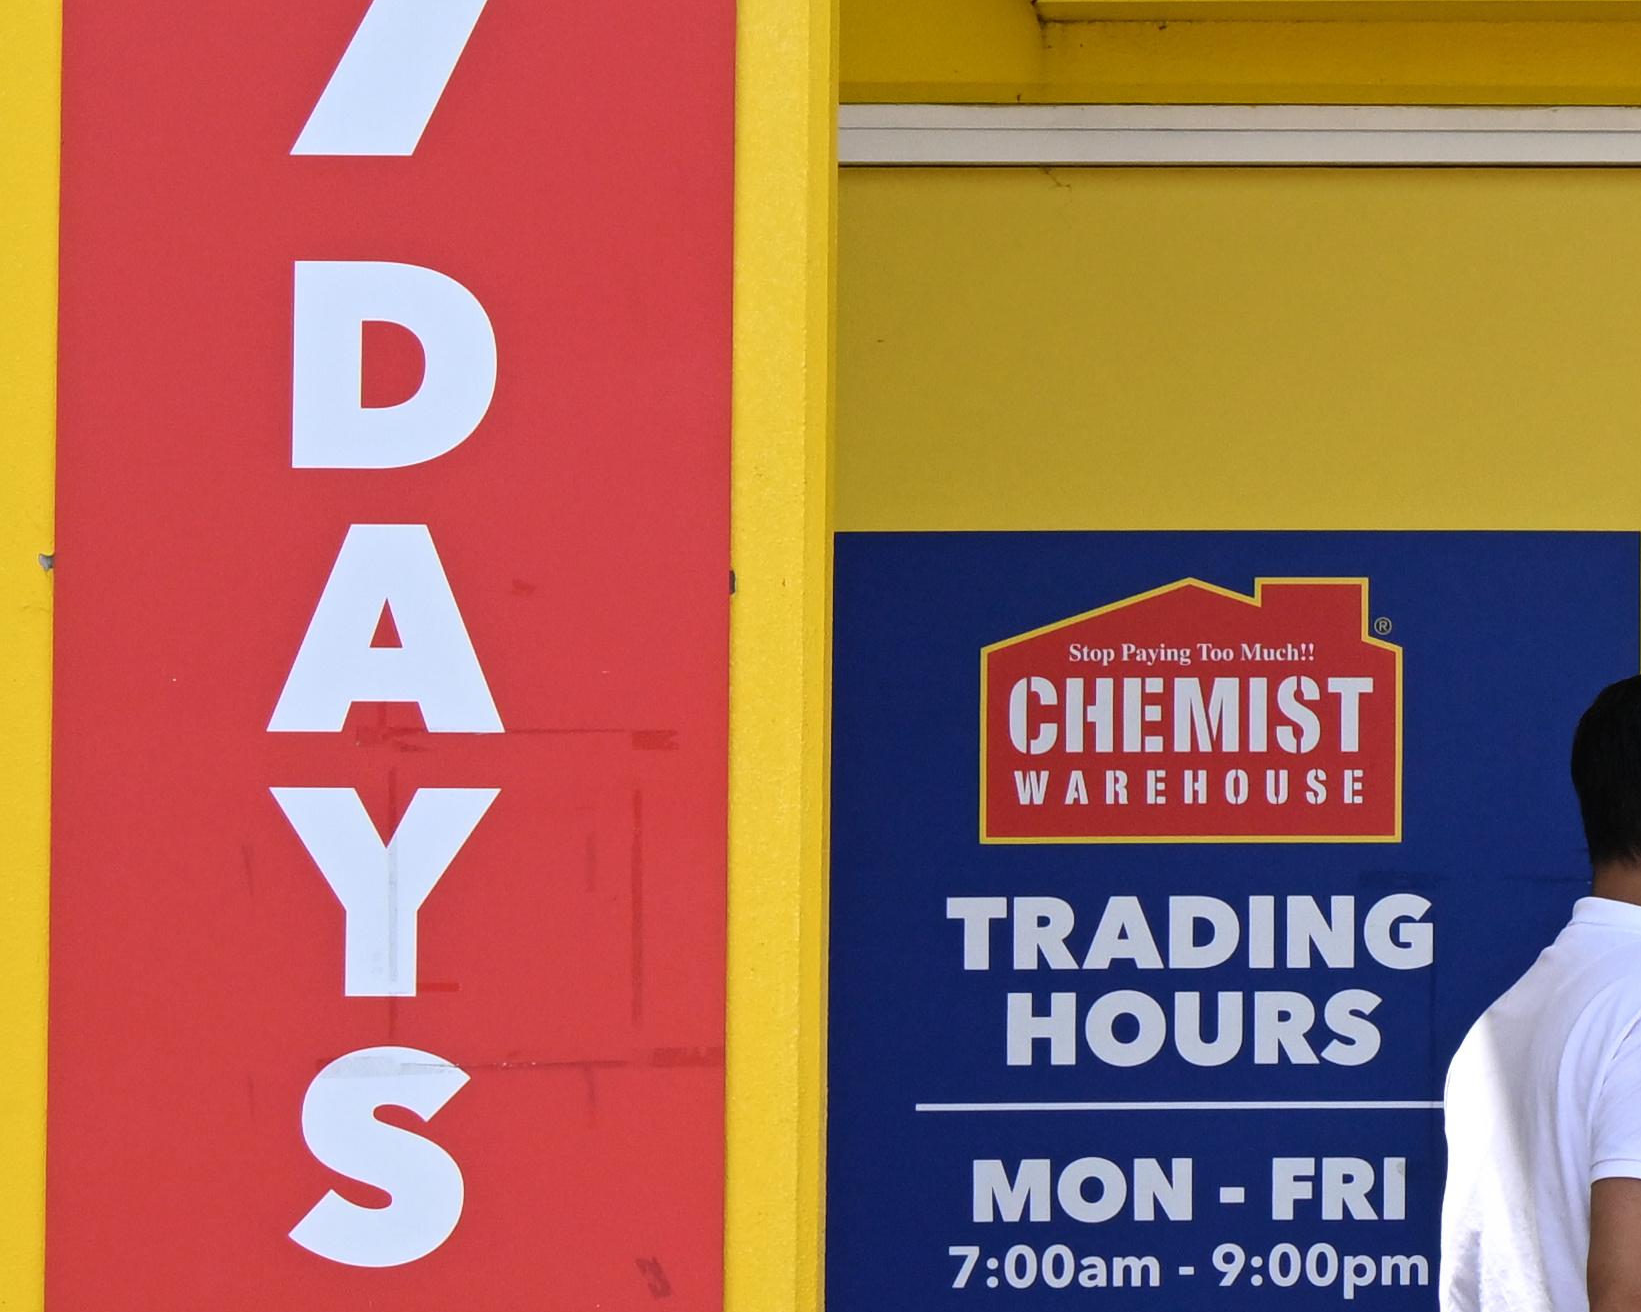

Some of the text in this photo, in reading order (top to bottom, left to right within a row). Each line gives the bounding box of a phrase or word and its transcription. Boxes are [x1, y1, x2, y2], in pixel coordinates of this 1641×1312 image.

[1069, 644, 1315, 665] Stop Paying Too Much!!
[1009, 676, 1374, 755] CHEMIST
[265, 260, 506, 1269] DAYS
[1014, 769, 1364, 805] WAREHOUSE
[946, 893, 1435, 971] TRADING
[1005, 989, 1383, 1069] HOURS
[971, 1157, 1406, 1224] MON FRI
[946, 1243, 1430, 1299] 7:00am 9:00pm
